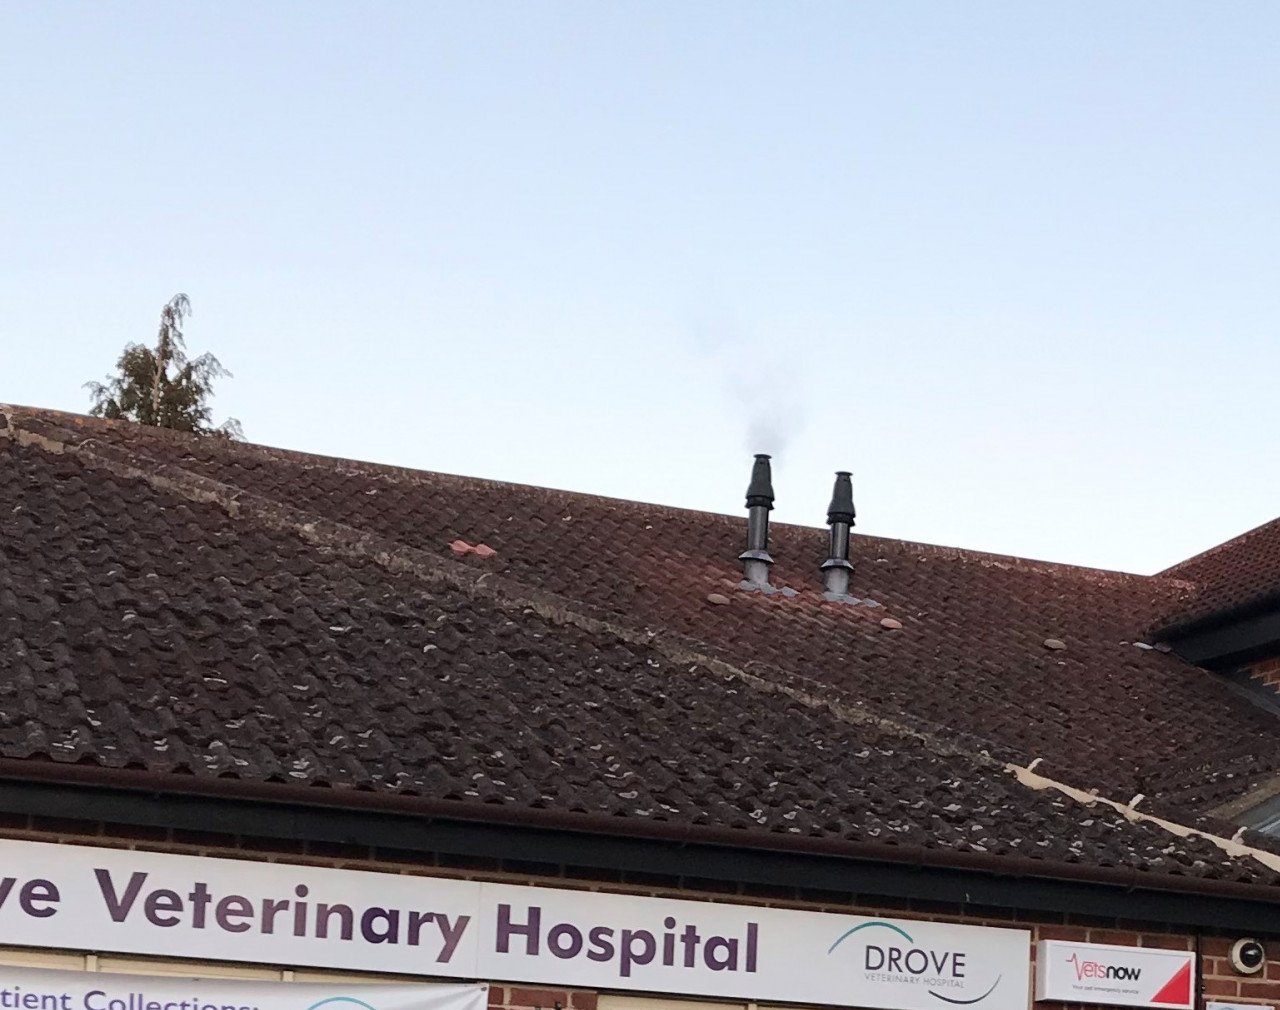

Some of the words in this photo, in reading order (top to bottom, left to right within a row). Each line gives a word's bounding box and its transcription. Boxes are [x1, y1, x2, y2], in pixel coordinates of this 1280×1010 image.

[93, 868, 471, 963] Veterinary
[495, 903, 759, 978] Hospital
[864, 944, 966, 978] DROVE
[863, 972, 921, 985] VETERINARY
[922, 977, 965, 989] HOSPITAL
